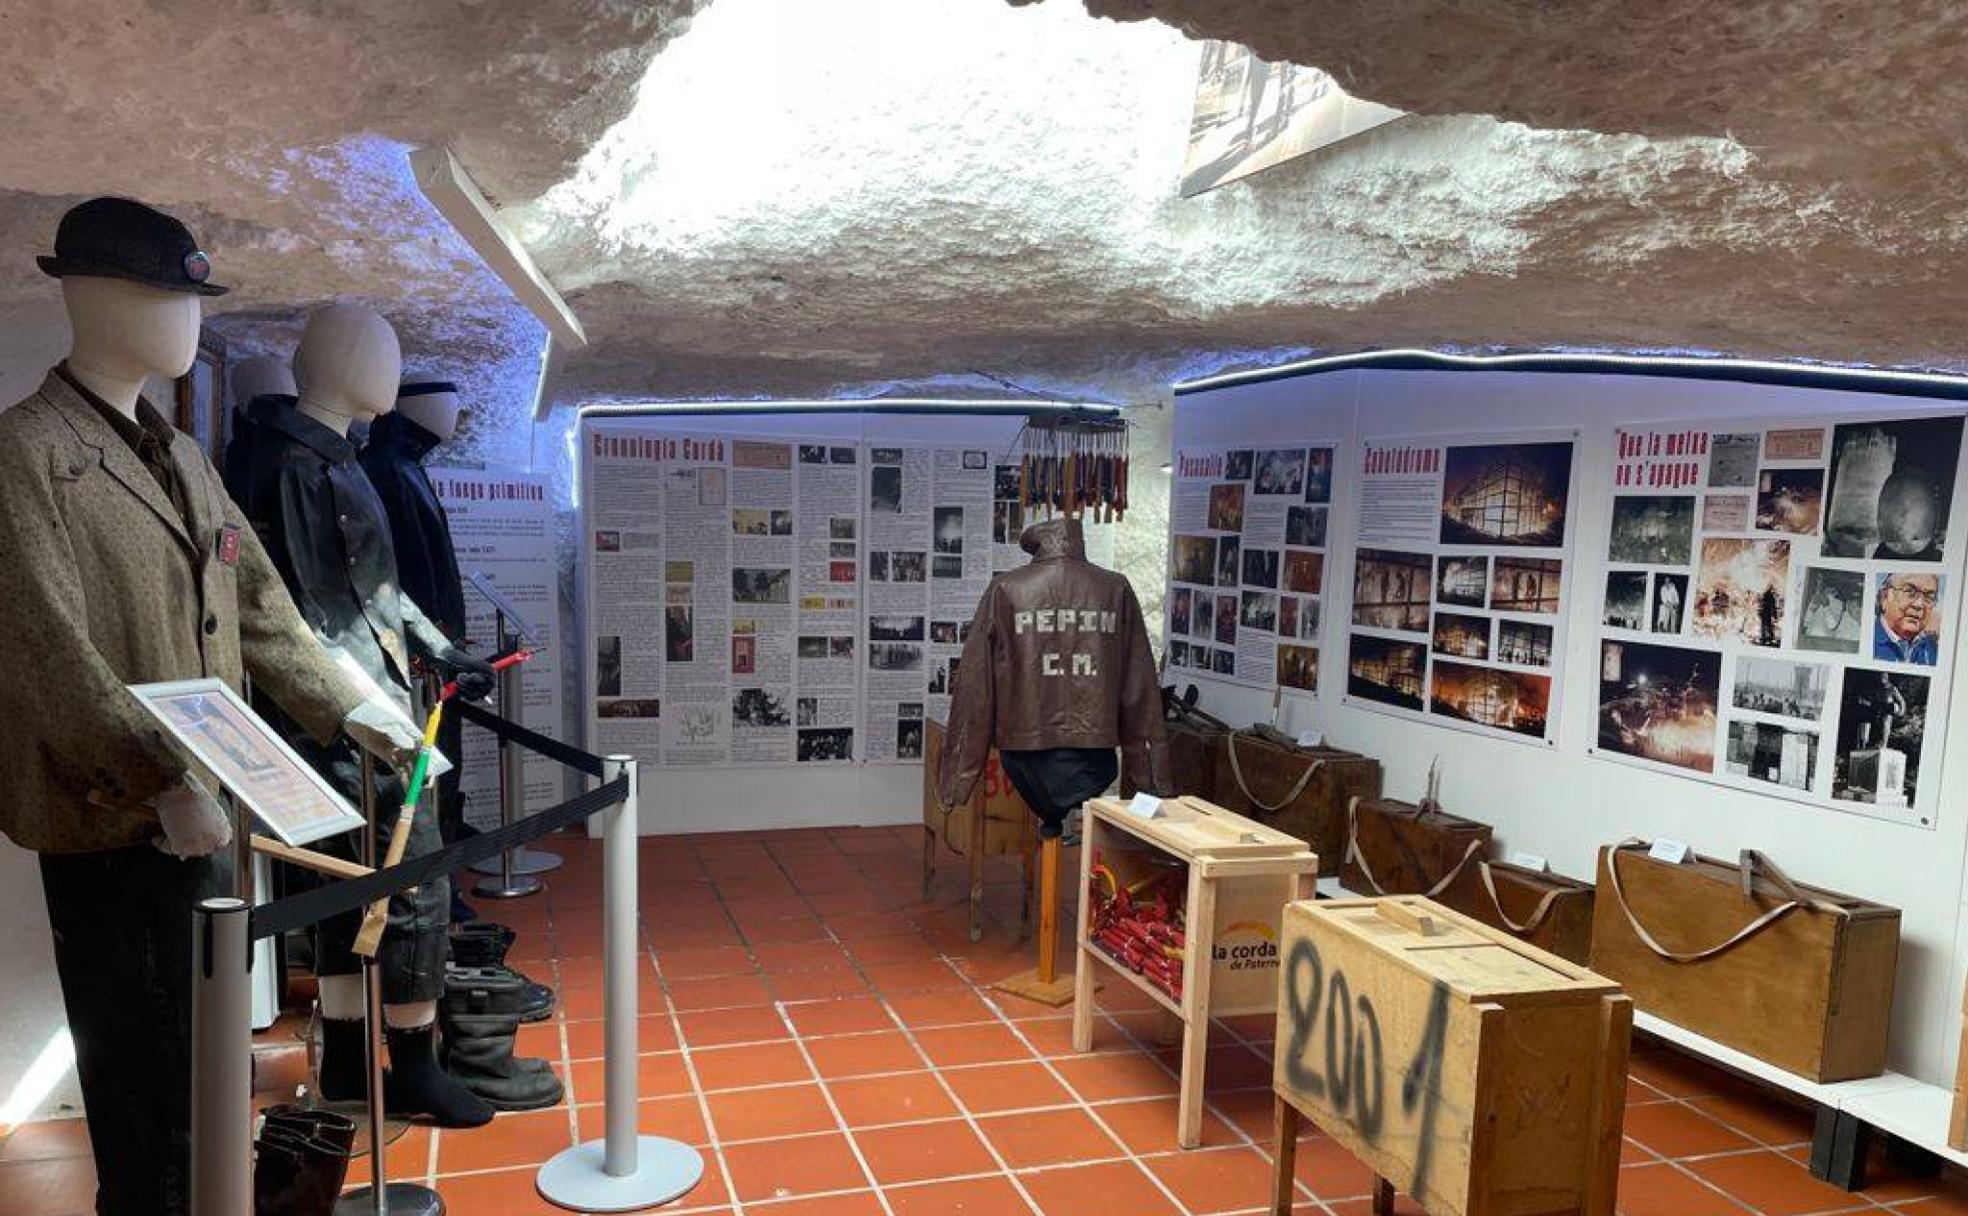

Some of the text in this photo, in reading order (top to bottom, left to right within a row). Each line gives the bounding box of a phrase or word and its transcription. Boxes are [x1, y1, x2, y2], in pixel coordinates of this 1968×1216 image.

[1618, 432, 1643, 460] Que
[1647, 431, 1661, 456] la
[1015, 608, 1117, 635] PEPIN
[1212, 941, 1278, 960] la corda
[1230, 959, 1242, 970] de
[1286, 936, 1451, 1201] 2001
